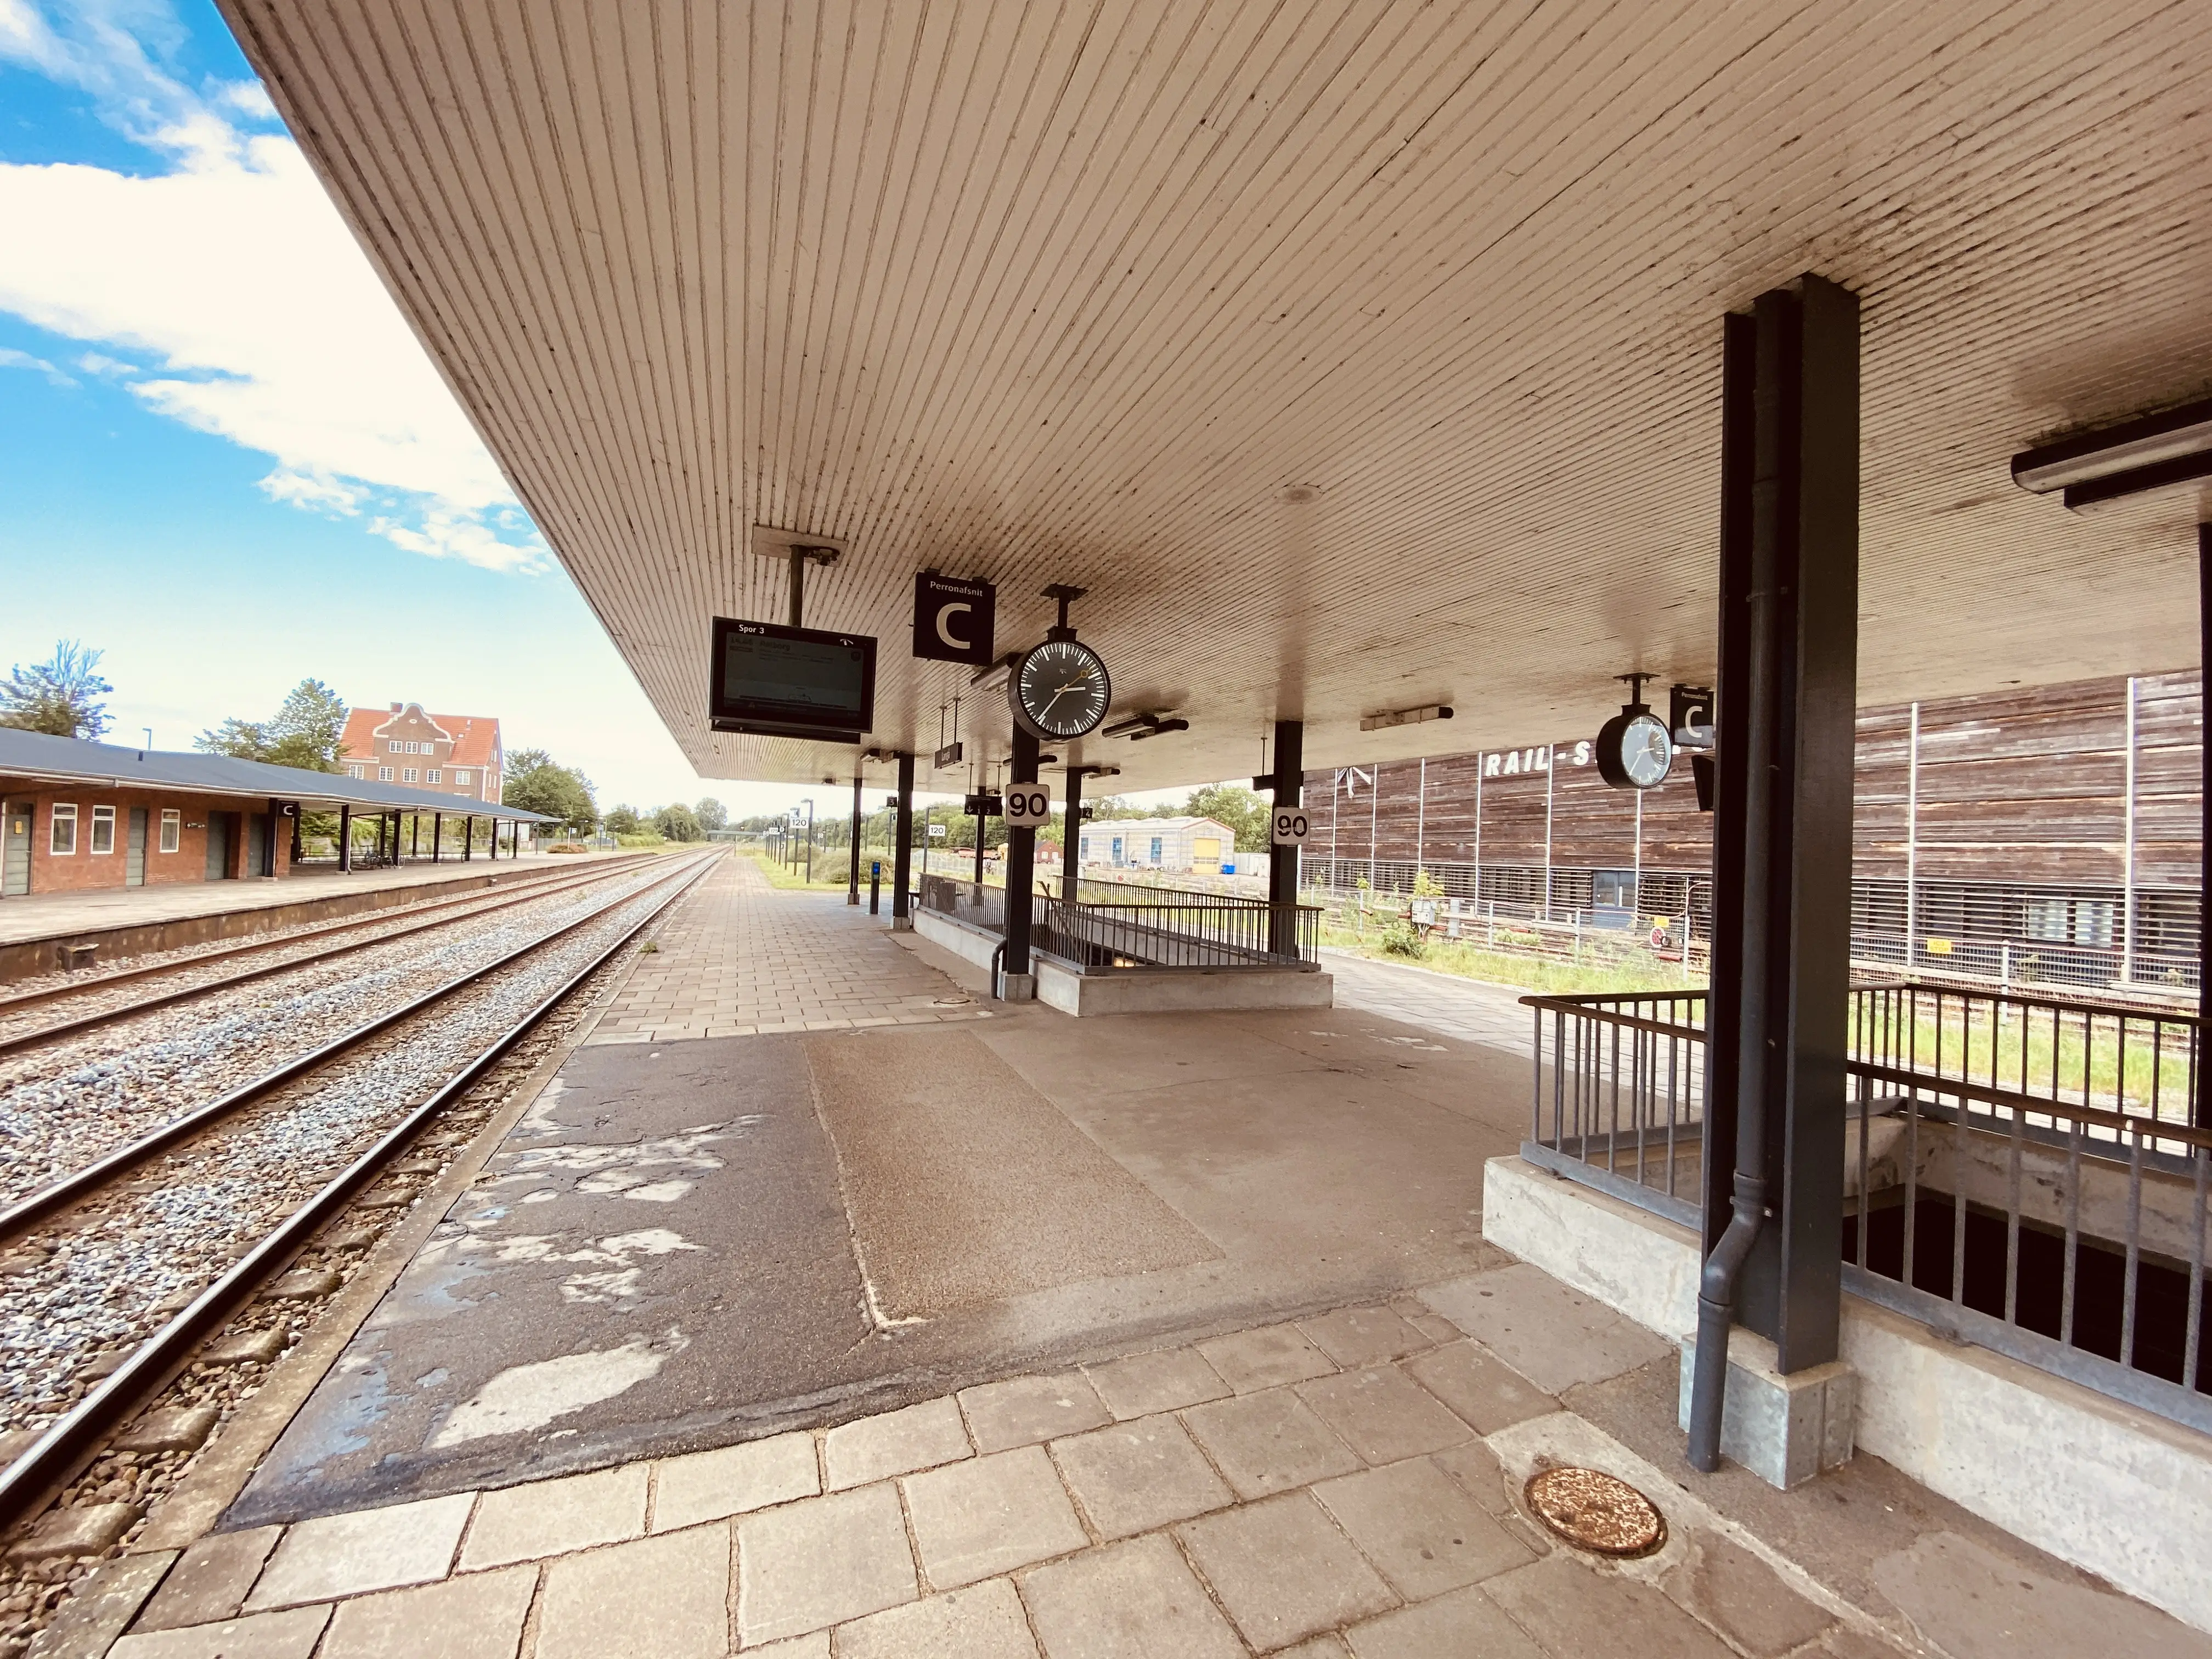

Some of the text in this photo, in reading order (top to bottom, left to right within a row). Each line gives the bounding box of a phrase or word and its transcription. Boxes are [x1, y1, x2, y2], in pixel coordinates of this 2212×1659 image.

[930, 580, 983, 597] Perronafsnit
[738, 624, 757, 634] Spor
[936, 602, 971, 649] C
[1685, 706, 1703, 738] C
[1485, 741, 1591, 777] RAIL-S
[283, 805, 293, 815] C
[1009, 792, 1047, 817] 90
[1277, 815, 1307, 837] 90
